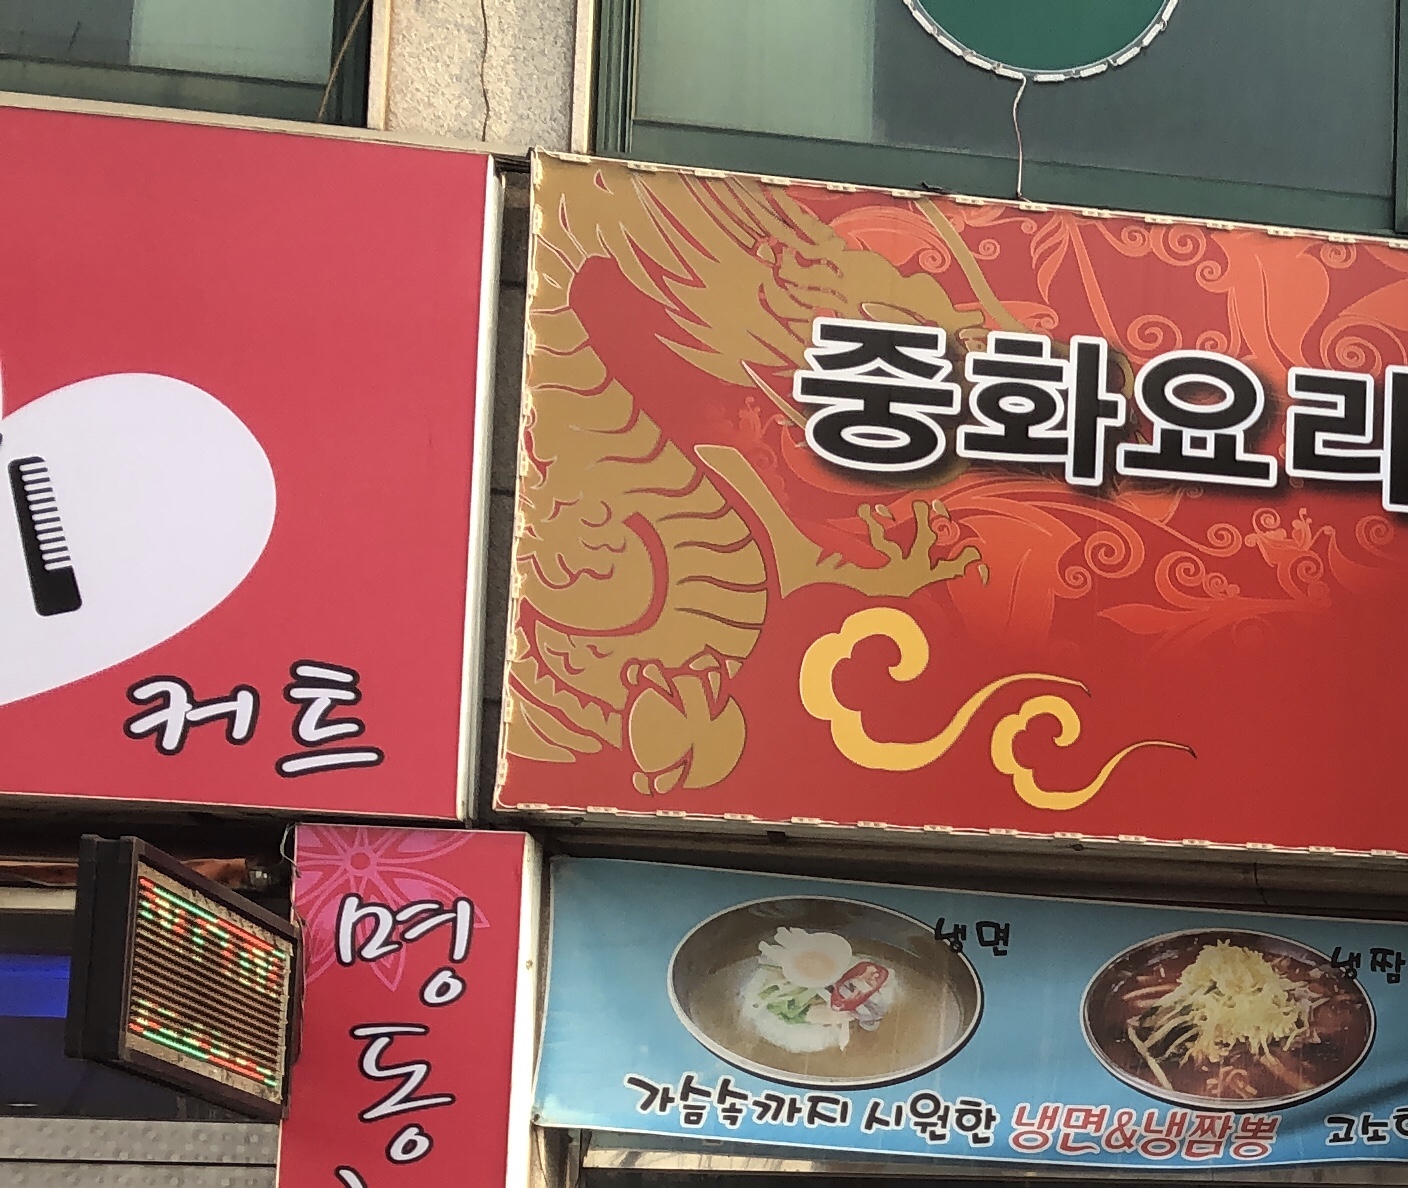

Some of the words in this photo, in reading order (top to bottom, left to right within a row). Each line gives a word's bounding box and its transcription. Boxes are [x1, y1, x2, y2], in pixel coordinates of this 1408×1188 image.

[123, 659, 384, 779] 커트
[936, 916, 1011, 958] 냉면
[623, 1071, 852, 1128] 가슴속까지
[863, 1091, 1000, 1147] 시원한
[1009, 1101, 1283, 1163] 냉면&냉짬뽕
